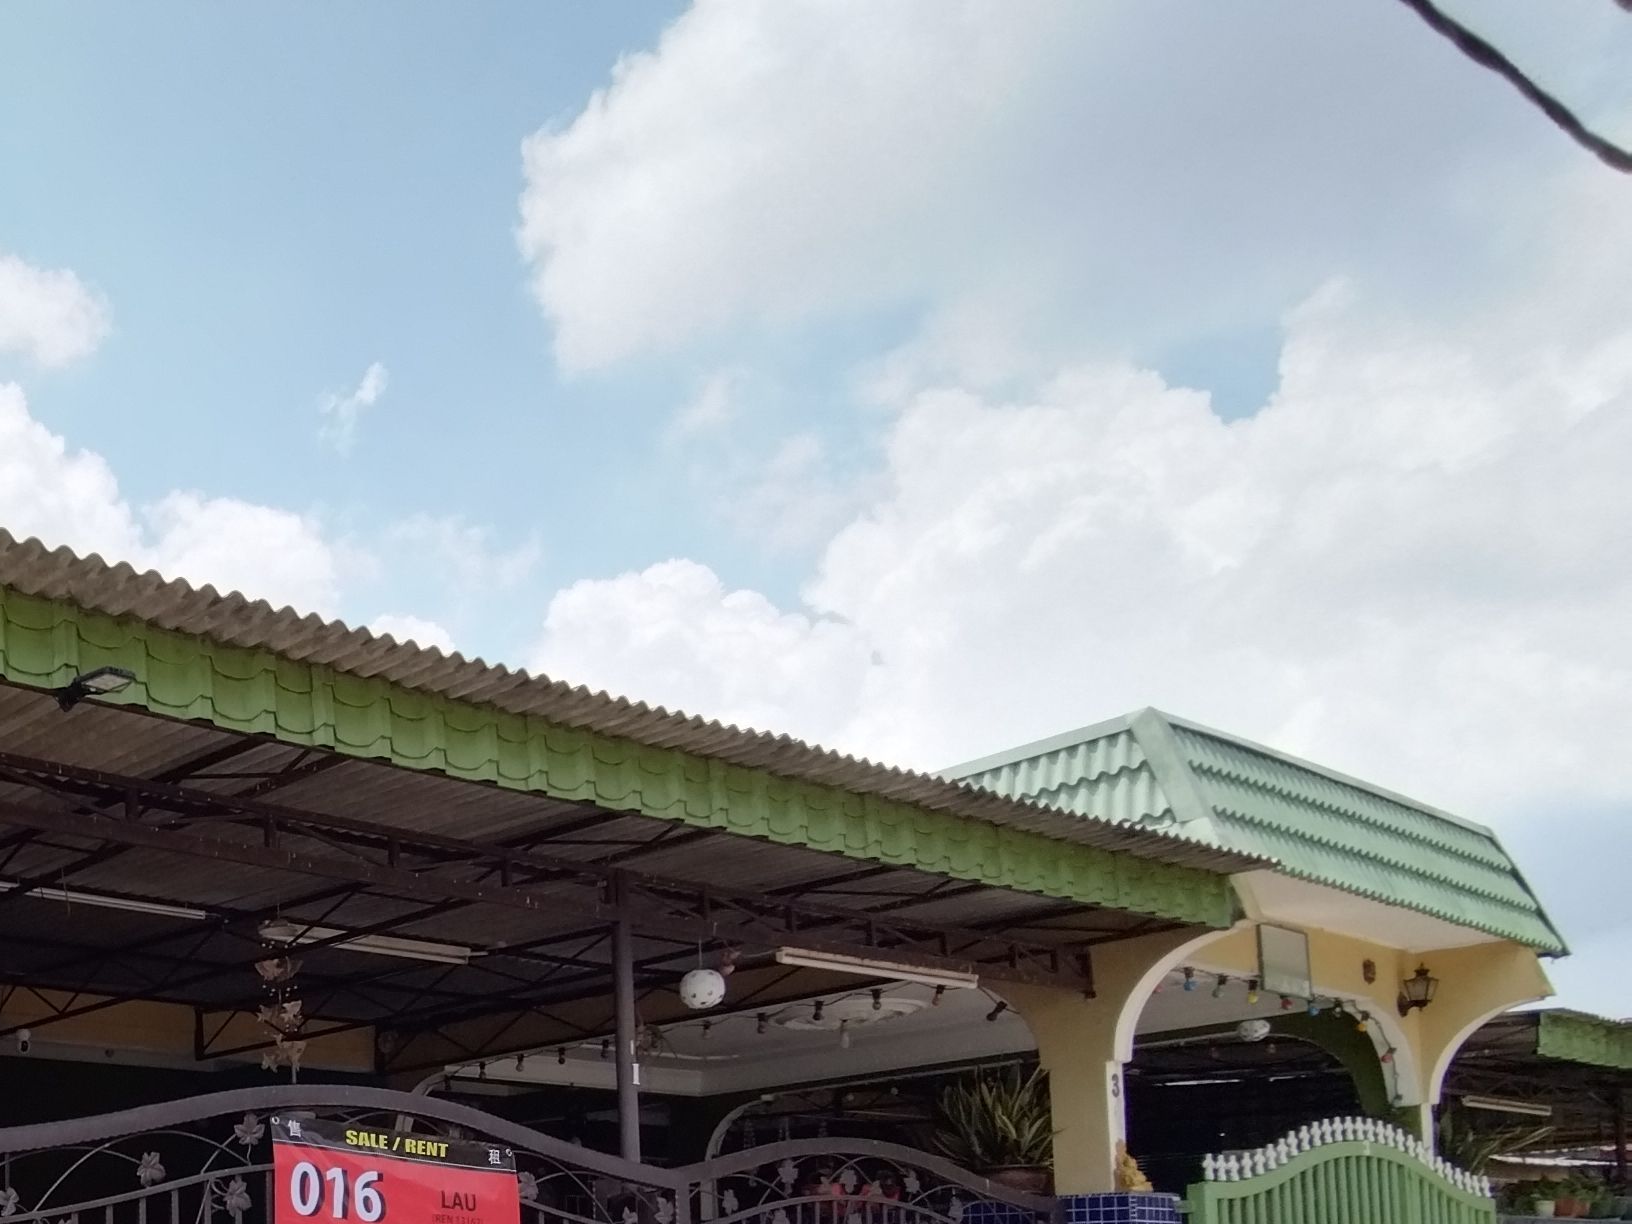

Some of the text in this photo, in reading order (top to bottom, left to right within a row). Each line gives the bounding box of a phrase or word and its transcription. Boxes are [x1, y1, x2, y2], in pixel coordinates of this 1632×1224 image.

[1111, 1073, 1120, 1098] 3
[288, 1119, 302, 1138] 售
[345, 1130, 449, 1158] SALE / RENT
[488, 1149, 501, 1165] 租
[290, 1161, 382, 1223] 016
[441, 1190, 476, 1211] LAU
